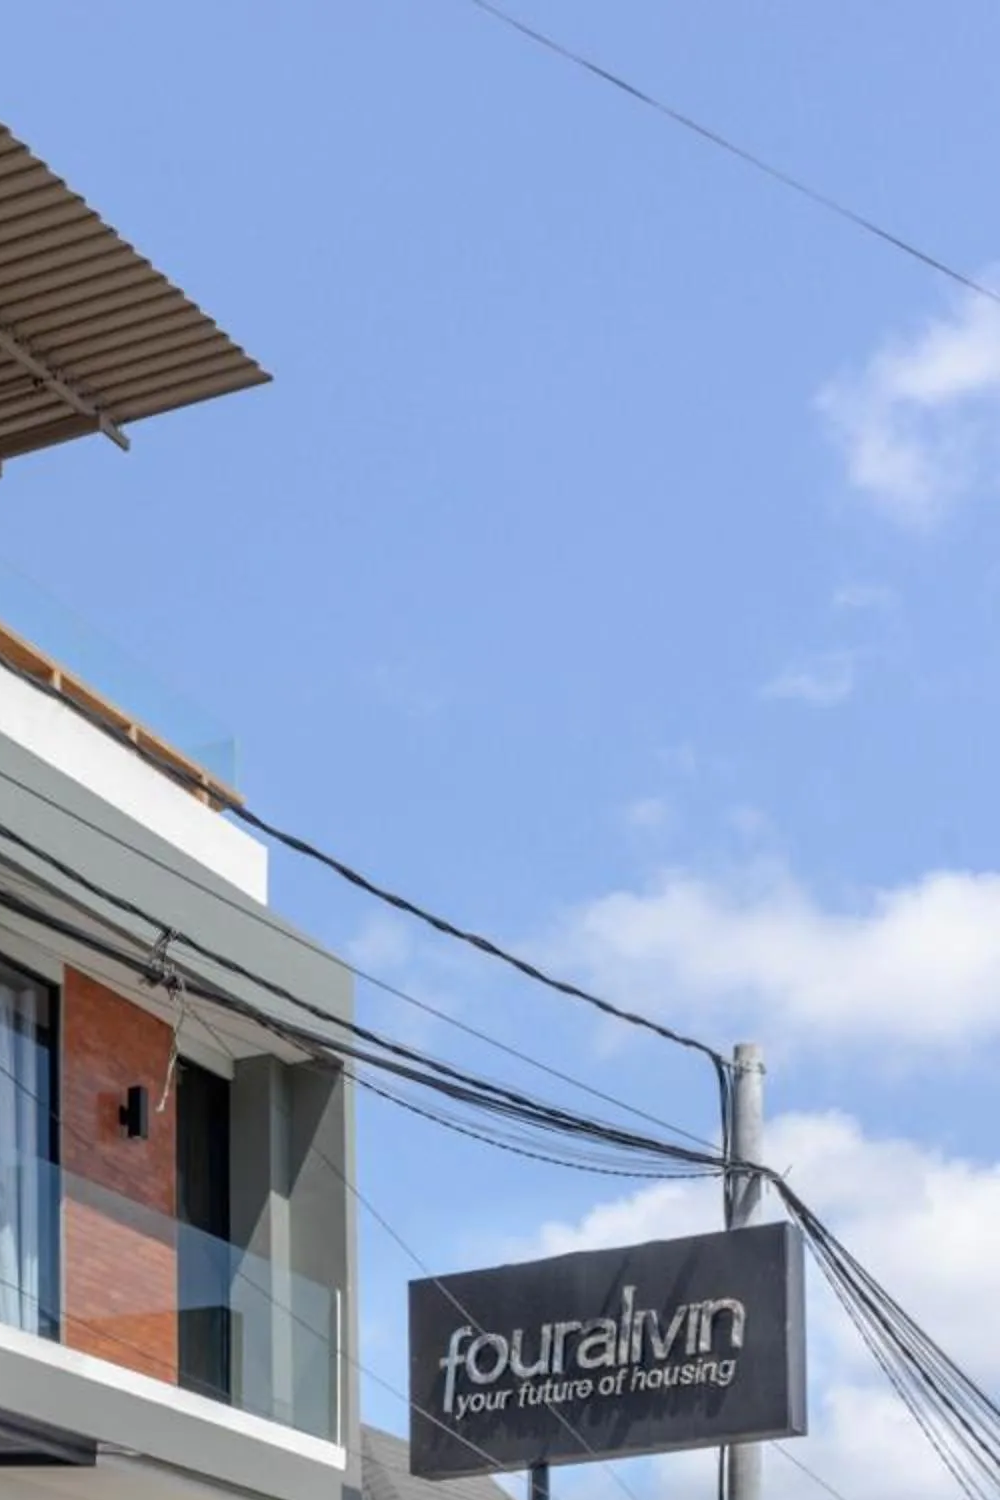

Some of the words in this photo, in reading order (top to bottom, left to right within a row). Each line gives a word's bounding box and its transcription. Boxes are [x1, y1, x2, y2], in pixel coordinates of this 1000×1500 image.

[455, 1388, 513, 1421] your
[518, 1377, 594, 1409] future
[597, 1367, 628, 1396] of
[630, 1357, 737, 1393] housing
